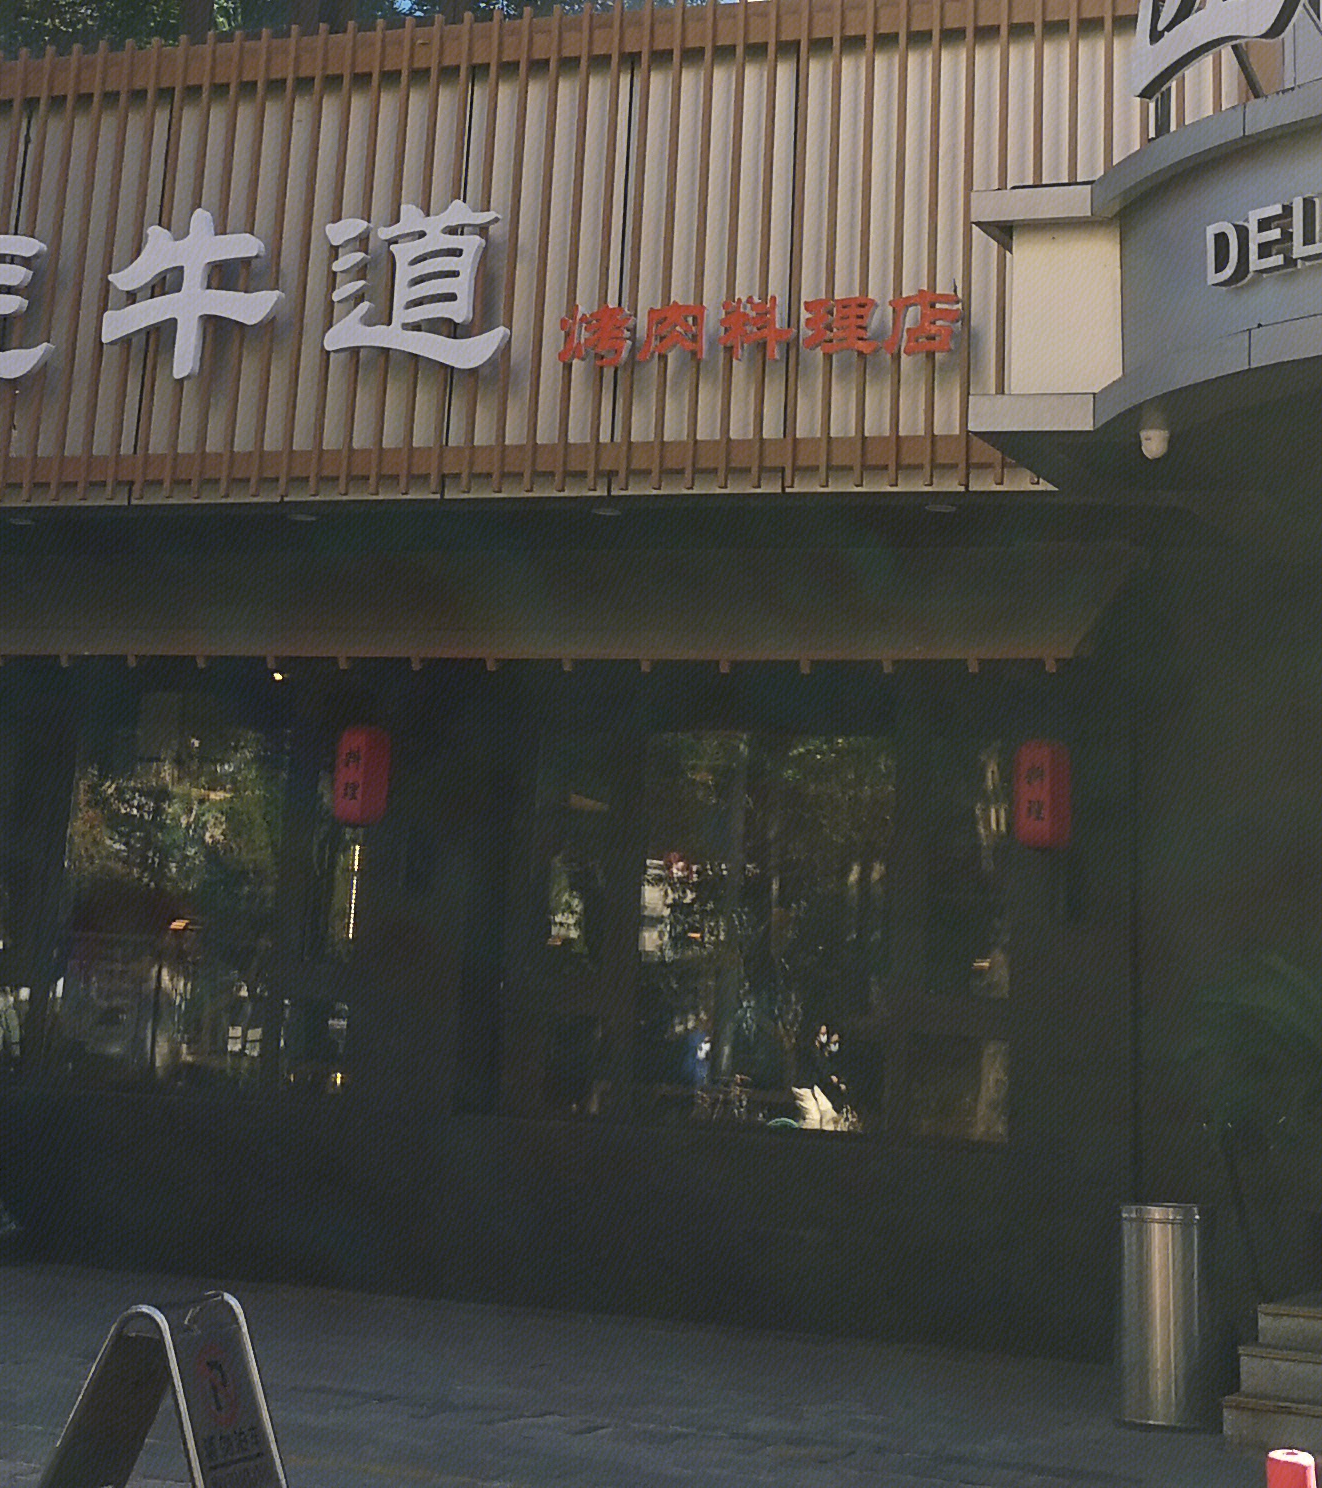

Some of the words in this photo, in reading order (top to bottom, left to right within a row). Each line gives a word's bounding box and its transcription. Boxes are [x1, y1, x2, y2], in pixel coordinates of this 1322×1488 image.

[558, 288, 962, 368] 烤肉料理店
